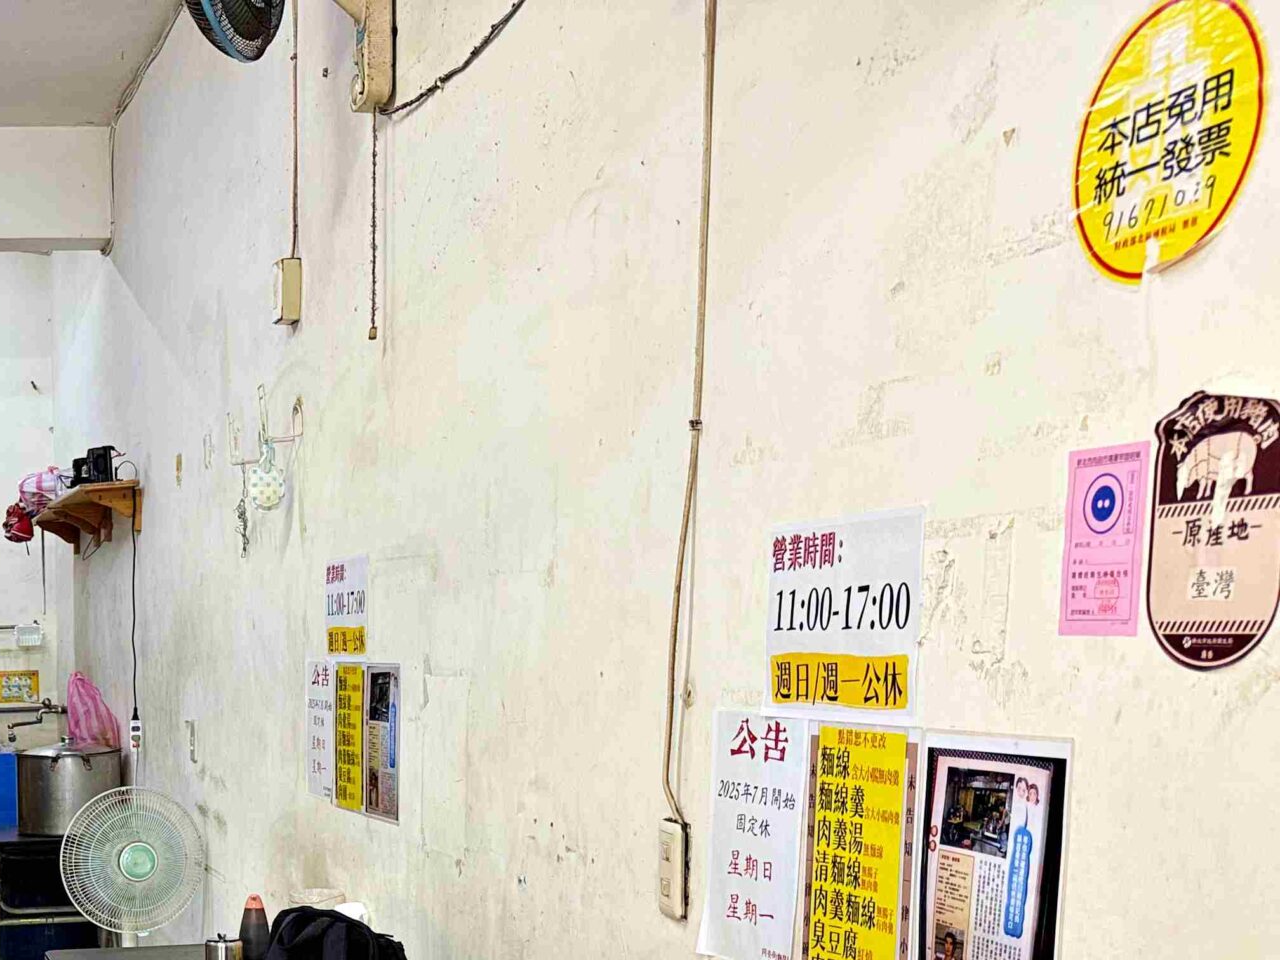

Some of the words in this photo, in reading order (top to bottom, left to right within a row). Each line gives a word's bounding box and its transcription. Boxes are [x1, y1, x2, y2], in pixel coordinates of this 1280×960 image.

[1097, 68, 1235, 156] 本店免用
[1093, 119, 1234, 207] 統一發票
[327, 590, 365, 616] 11:00-17:00
[1191, 568, 1235, 601] 臺灣
[773, 581, 911, 632] 11:00-17:00
[774, 661, 904, 706] 週日/週一公休
[729, 717, 790, 763] 公告
[820, 745, 851, 779] 麵線
[717, 777, 797, 812] 2025年7月開始
[818, 780, 865, 819] 麵線羹
[735, 813, 771, 838] 固定休
[816, 815, 864, 855] 肉羹湯
[727, 849, 773, 882] 星期日
[814, 849, 861, 890] 清麵線
[726, 893, 774, 926] 星期一
[813, 885, 876, 930] 肉羹麵線
